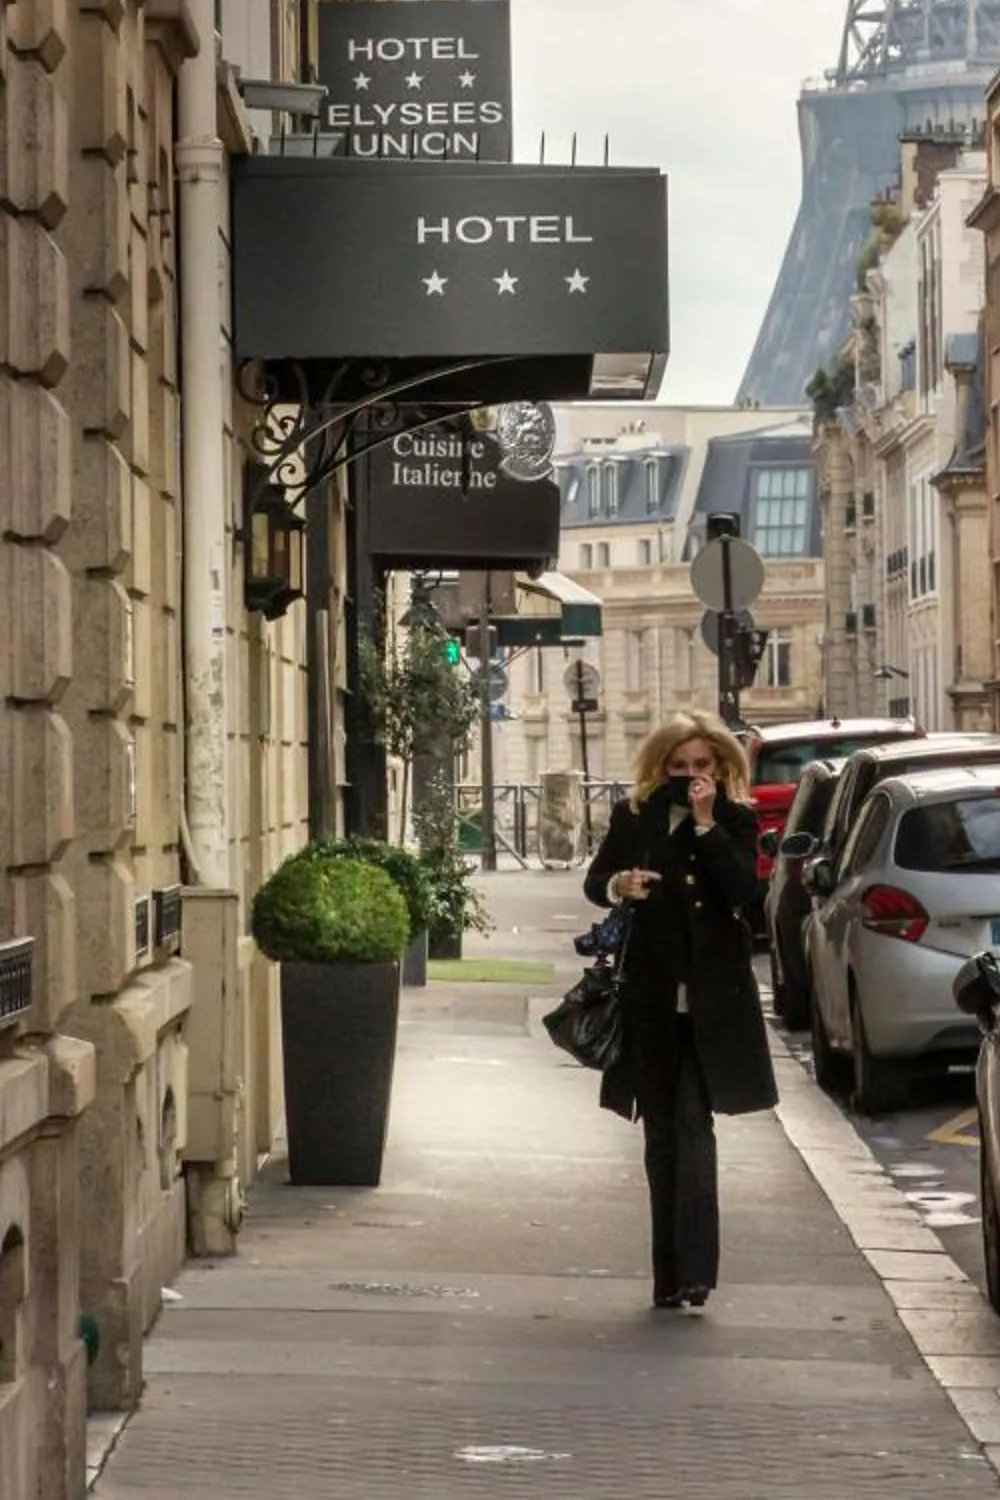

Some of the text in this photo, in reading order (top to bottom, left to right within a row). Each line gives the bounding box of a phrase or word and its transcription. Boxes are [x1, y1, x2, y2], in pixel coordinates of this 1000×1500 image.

[348, 37, 479, 61] HOTEL
[328, 100, 504, 126] ELYSEES
[353, 131, 478, 156] UNION
[416, 215, 594, 245] HOTEL
